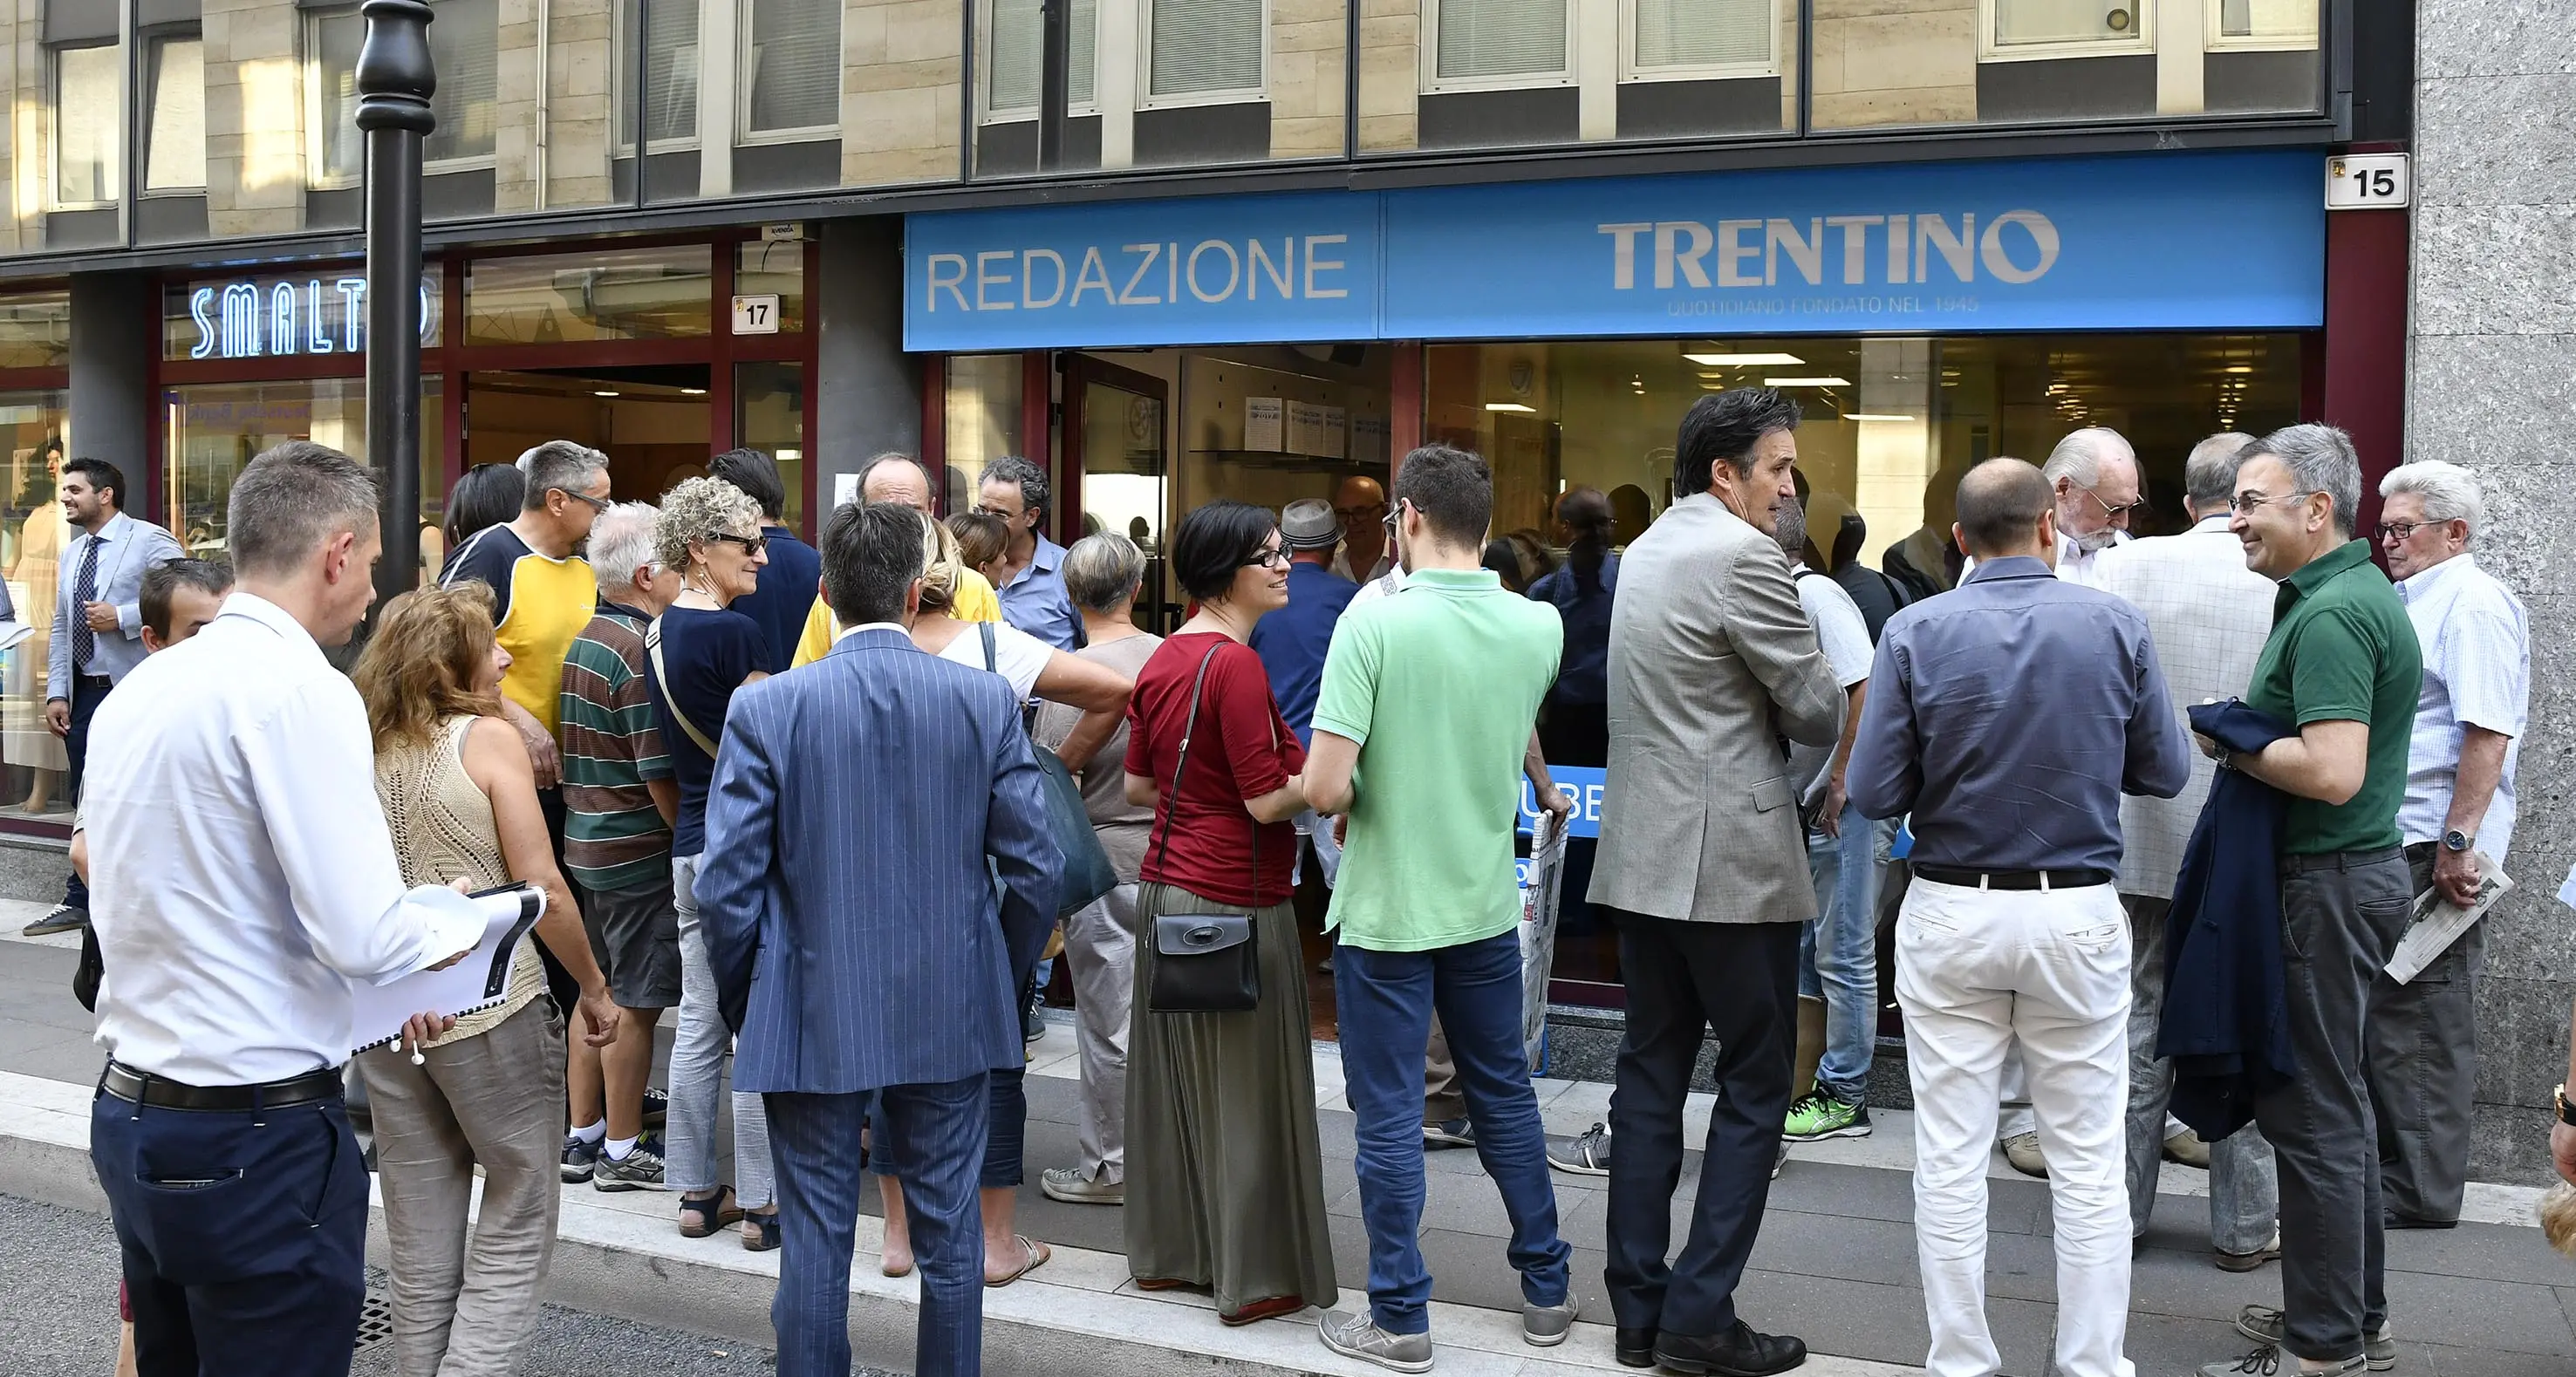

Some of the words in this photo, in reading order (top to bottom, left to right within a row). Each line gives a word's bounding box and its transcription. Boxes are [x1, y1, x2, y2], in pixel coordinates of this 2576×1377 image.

[2354, 168, 2395, 197] 15
[928, 234, 1348, 312] REDAZIONE
[1597, 209, 2060, 290] TRENTINO
[191, 278, 429, 359] SMALT
[747, 304, 769, 325] 17
[1667, 298, 1785, 317] QUOTIDIANO
[1792, 297, 1882, 315] FONDATO
[1888, 297, 1924, 314] NEL
[1936, 296, 1979, 313] 1945
